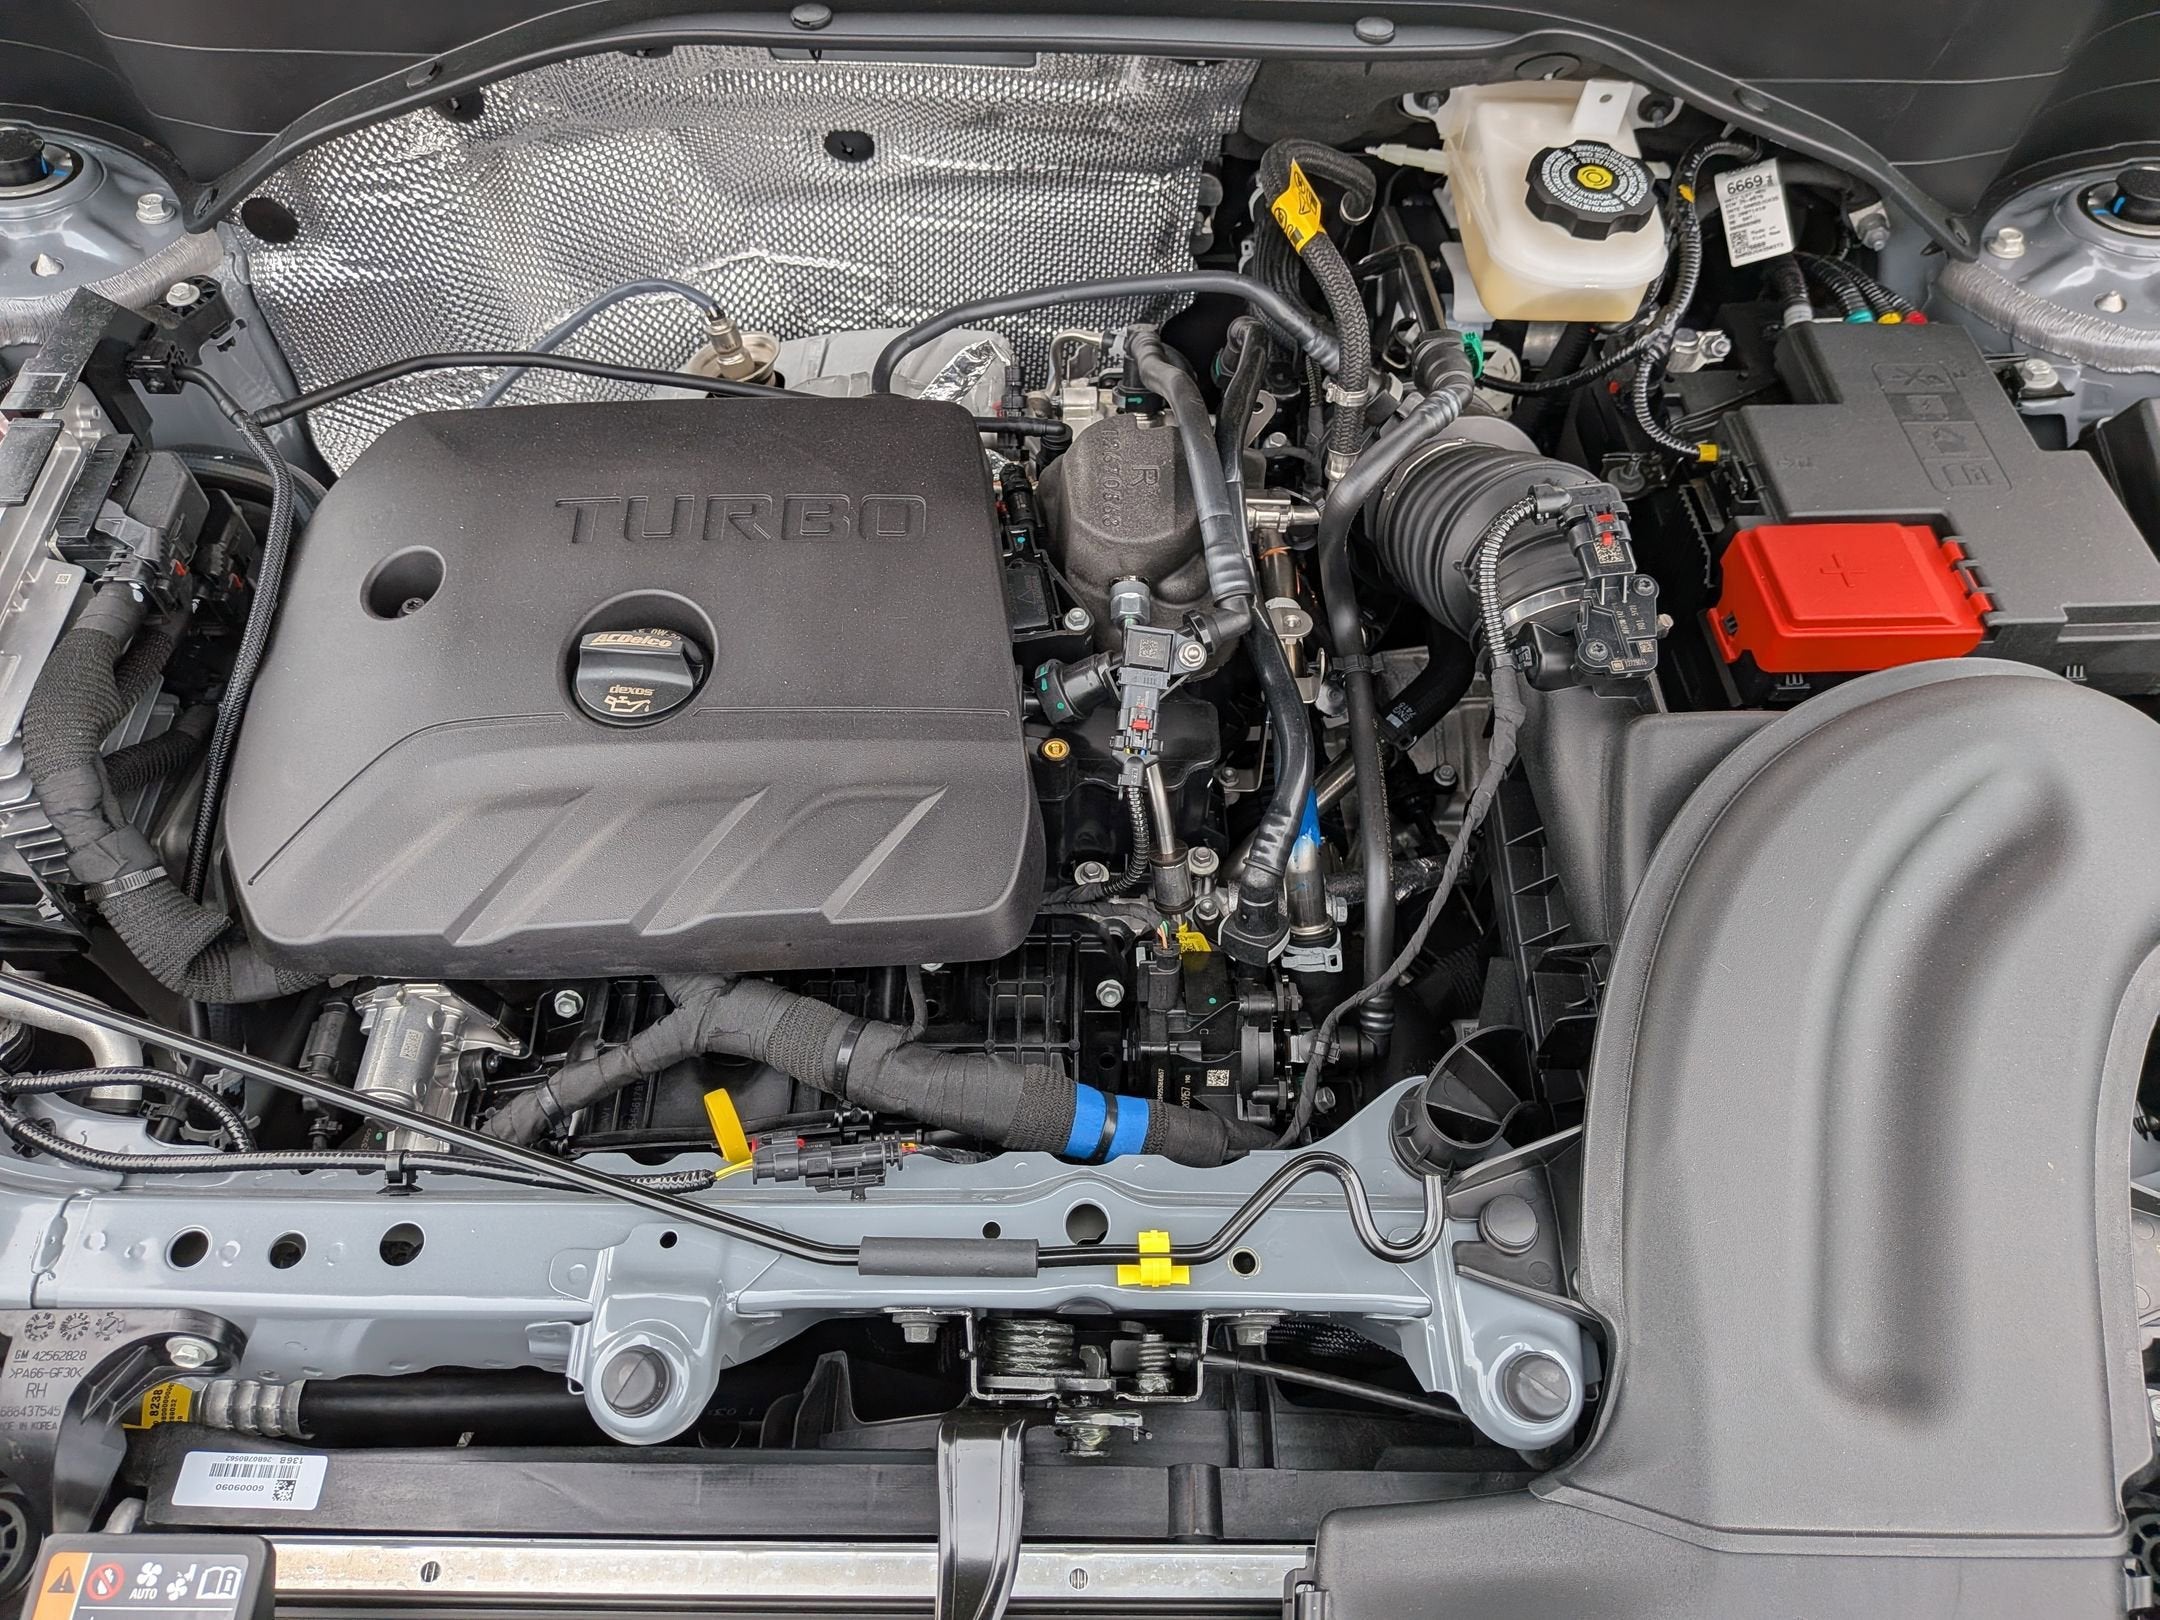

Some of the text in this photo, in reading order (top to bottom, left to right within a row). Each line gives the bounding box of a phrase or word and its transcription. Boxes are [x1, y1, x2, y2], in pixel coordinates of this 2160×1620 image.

[1727, 175, 1763, 195] 6669
[1133, 464, 1160, 488] R
[555, 494, 928, 544] TURBO
[591, 633, 673, 648] ACDelco
[609, 684, 656, 697] dexos
[1392, 706, 1411, 723] ENG
[14, 1349, 87, 1362] GM 42562828
[25, 1382, 48, 1399] RH
[149, 1389, 164, 1417] 8238
[279, 1456, 304, 1465] 136B
[215, 1483, 265, 1492] 60009090
[128, 1587, 159, 1600] AUTO
